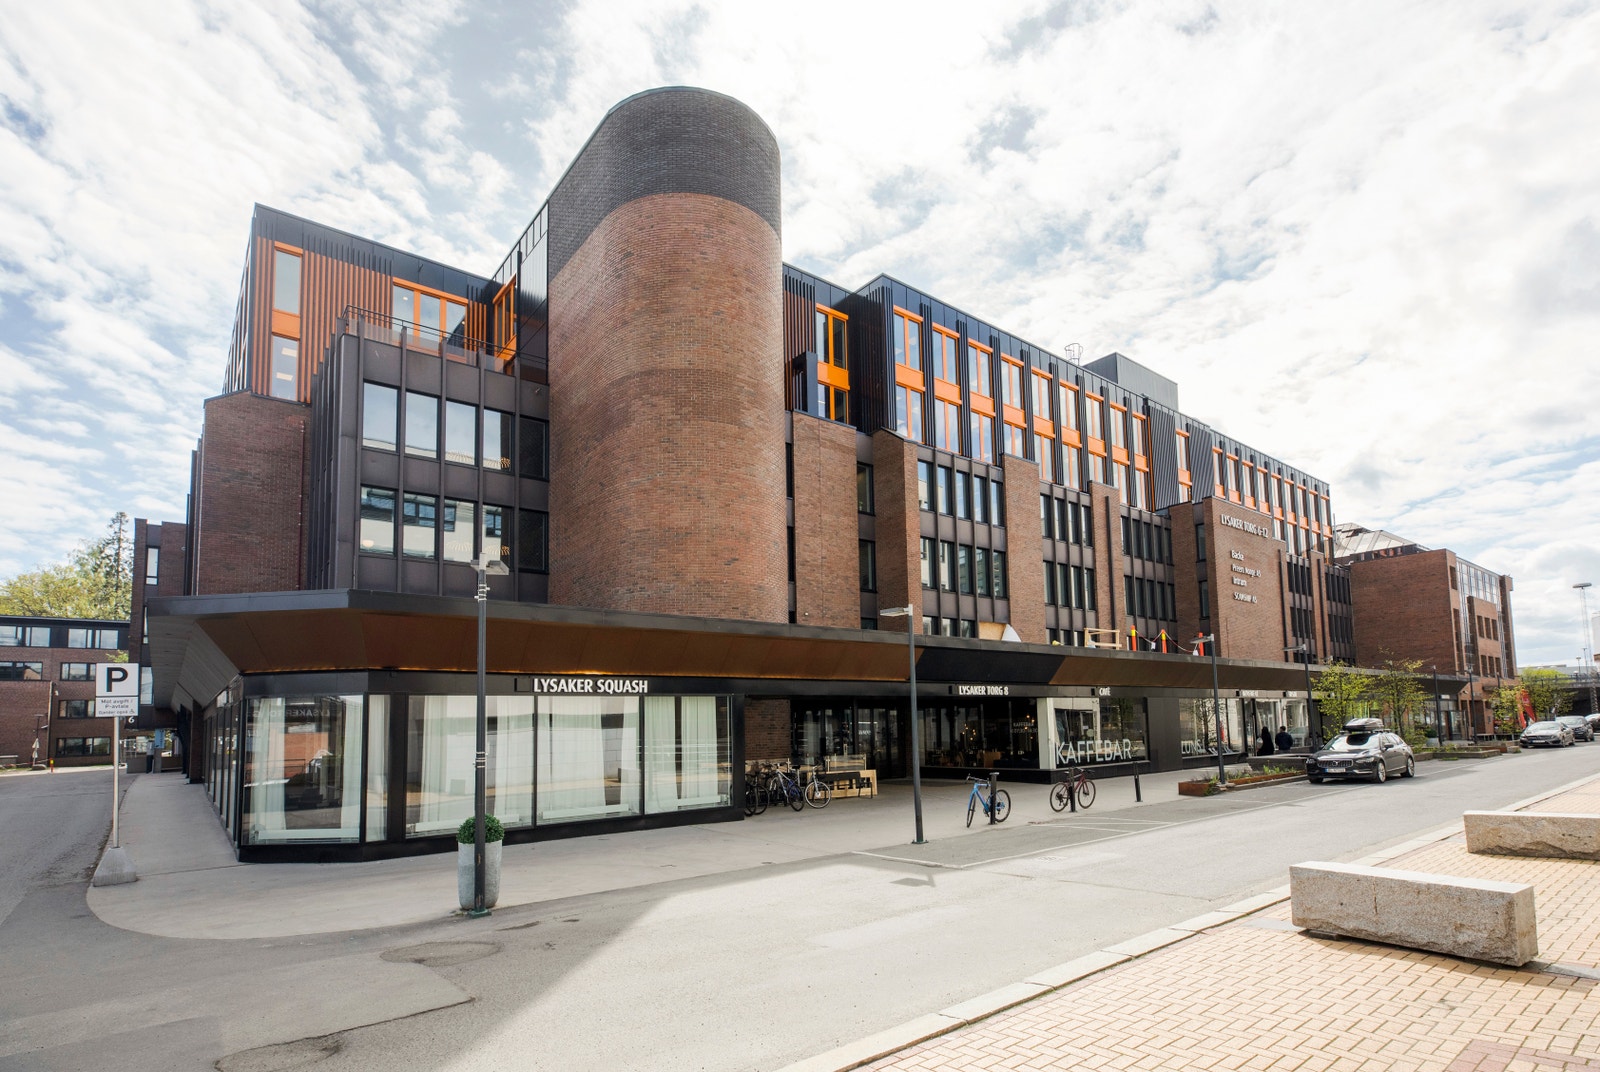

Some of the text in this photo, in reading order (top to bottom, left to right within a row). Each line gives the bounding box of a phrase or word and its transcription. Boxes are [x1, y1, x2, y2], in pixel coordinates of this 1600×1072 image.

[1221, 513, 1244, 530] LYSAKER
[1243, 521, 1258, 535] TORG
[106, 667, 128, 692] P
[533, 678, 648, 694] LYSAKER SQUASH
[959, 685, 1009, 696] LYSAKER TORG 8
[1056, 738, 1132, 765] KAFFEBAR
